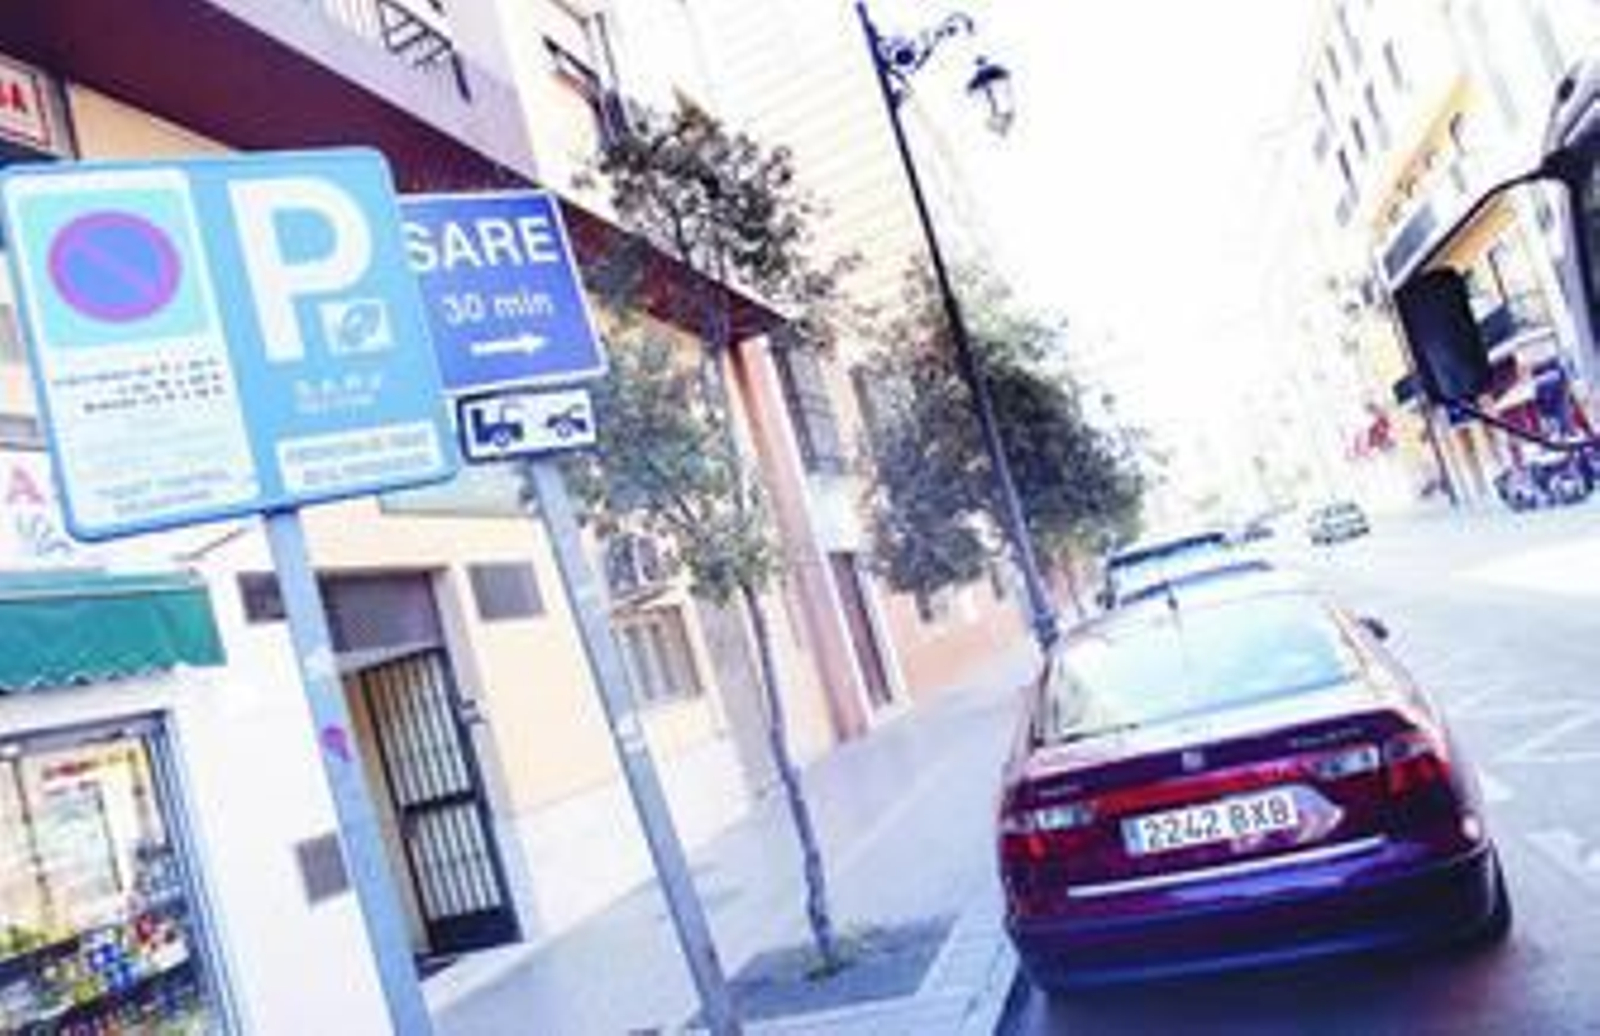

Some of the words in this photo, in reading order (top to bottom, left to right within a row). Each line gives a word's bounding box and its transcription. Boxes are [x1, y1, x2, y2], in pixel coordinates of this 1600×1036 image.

[227, 175, 373, 362] P
[402, 216, 558, 273] SARE
[441, 292, 486, 325] 30
[494, 288, 555, 318] min
[1143, 809, 1222, 848] 2242
